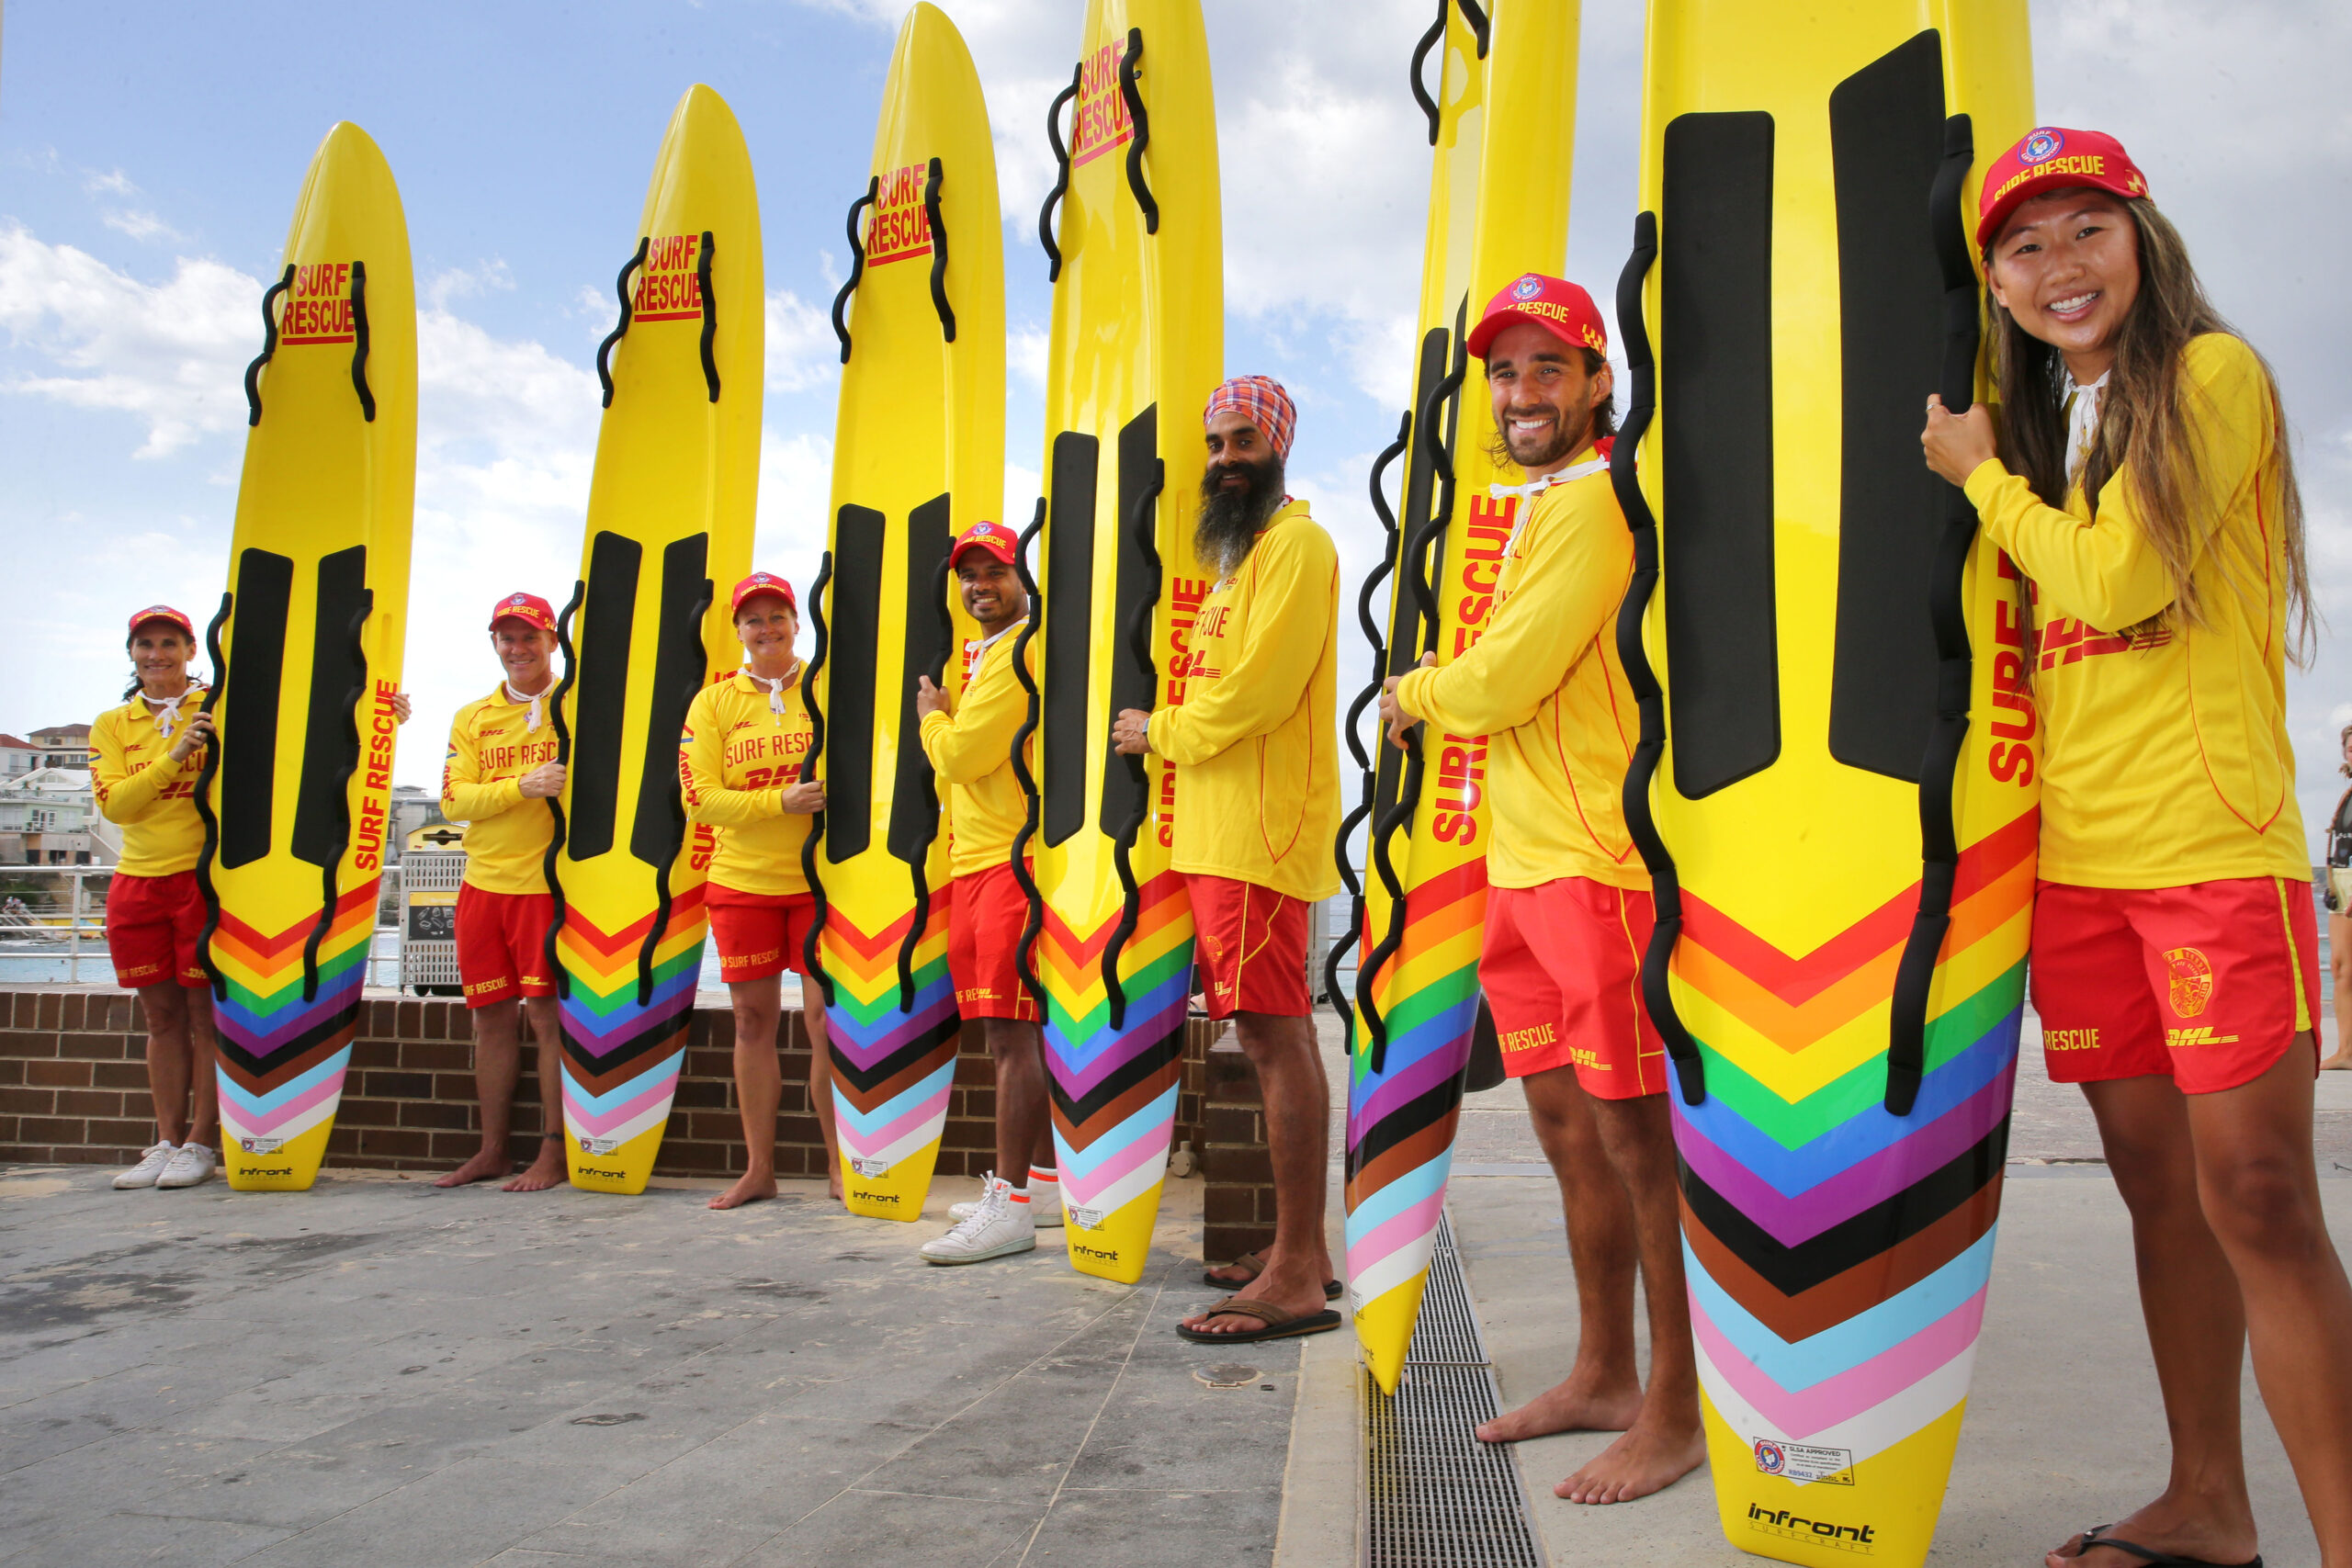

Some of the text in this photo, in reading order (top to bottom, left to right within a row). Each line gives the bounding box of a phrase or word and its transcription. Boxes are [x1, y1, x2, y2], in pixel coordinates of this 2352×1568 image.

[1081, 38, 1125, 101] SURF
[878, 163, 925, 210] SURF
[649, 234, 698, 272] SURF
[296, 263, 350, 298] SURF
[479, 741, 557, 773] SURF RESC
[726, 732, 814, 769] SURF RESC
[355, 679, 398, 872] SURF RESCUE
[679, 750, 701, 807] AMPOL
[734, 762, 805, 792] DH
[728, 947, 779, 968] SURF RESCUE
[476, 976, 507, 995] RESCUE
[1508, 1022, 1557, 1054] RESCUE
[2043, 1028, 2101, 1051] RESCUE
[2165, 1027, 2240, 1047] DHL
[240, 1168, 293, 1176] infront
[578, 1166, 627, 1179] infront
[853, 1190, 900, 1203] infront
[1073, 1243, 1119, 1261] infront
[1805, 1448, 1841, 1457] APPROVED
[1748, 1502, 1875, 1543] infront
[1748, 1521, 1871, 1554] SURFCRAFT
